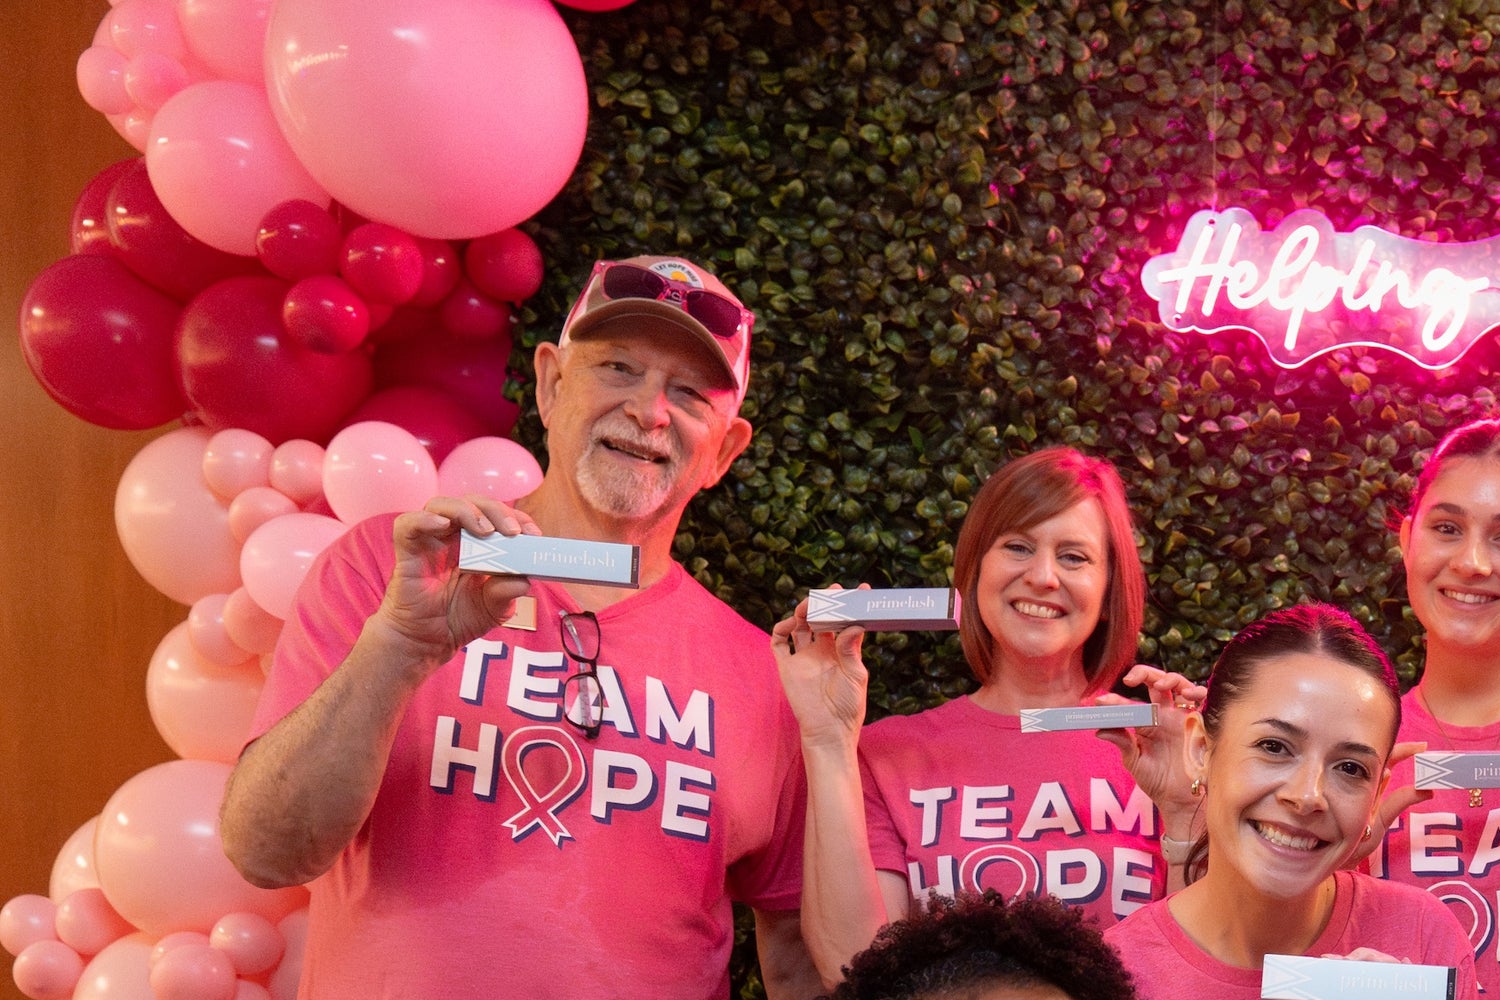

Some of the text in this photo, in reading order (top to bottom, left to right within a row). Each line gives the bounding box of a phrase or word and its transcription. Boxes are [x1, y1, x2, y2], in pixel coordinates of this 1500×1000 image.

[1157, 223, 1490, 352] Helping
[532, 547, 616, 569] primelash
[866, 595, 936, 613] primelash
[458, 638, 716, 759] TEAM
[429, 715, 716, 850] HOPE
[909, 777, 1161, 847] TEAM
